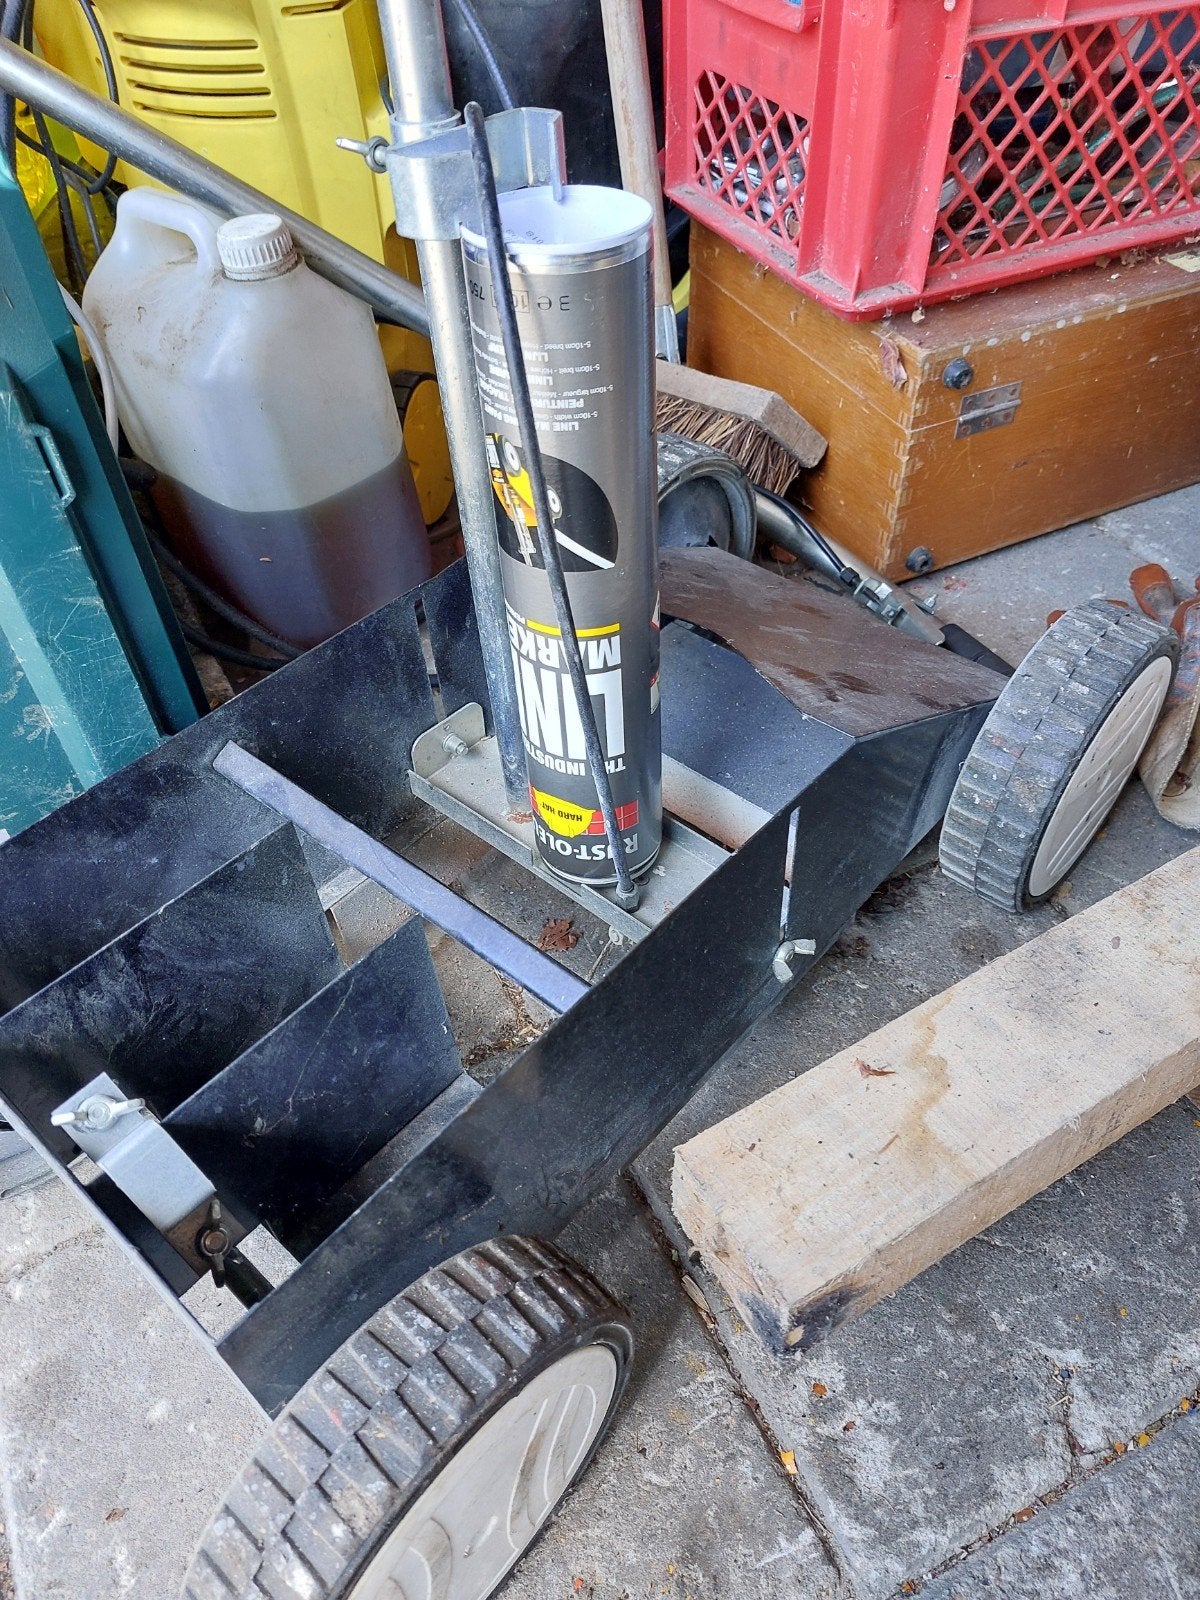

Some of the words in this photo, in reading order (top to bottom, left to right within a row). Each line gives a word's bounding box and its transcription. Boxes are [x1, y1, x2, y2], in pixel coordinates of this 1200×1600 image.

[530, 398, 584, 409] PEINTUR
[552, 421, 579, 431] LINE
[511, 642, 626, 760] LIN
[604, 757, 626, 774] TH
[541, 802, 555, 814] HAT
[558, 810, 582, 822] HARD
